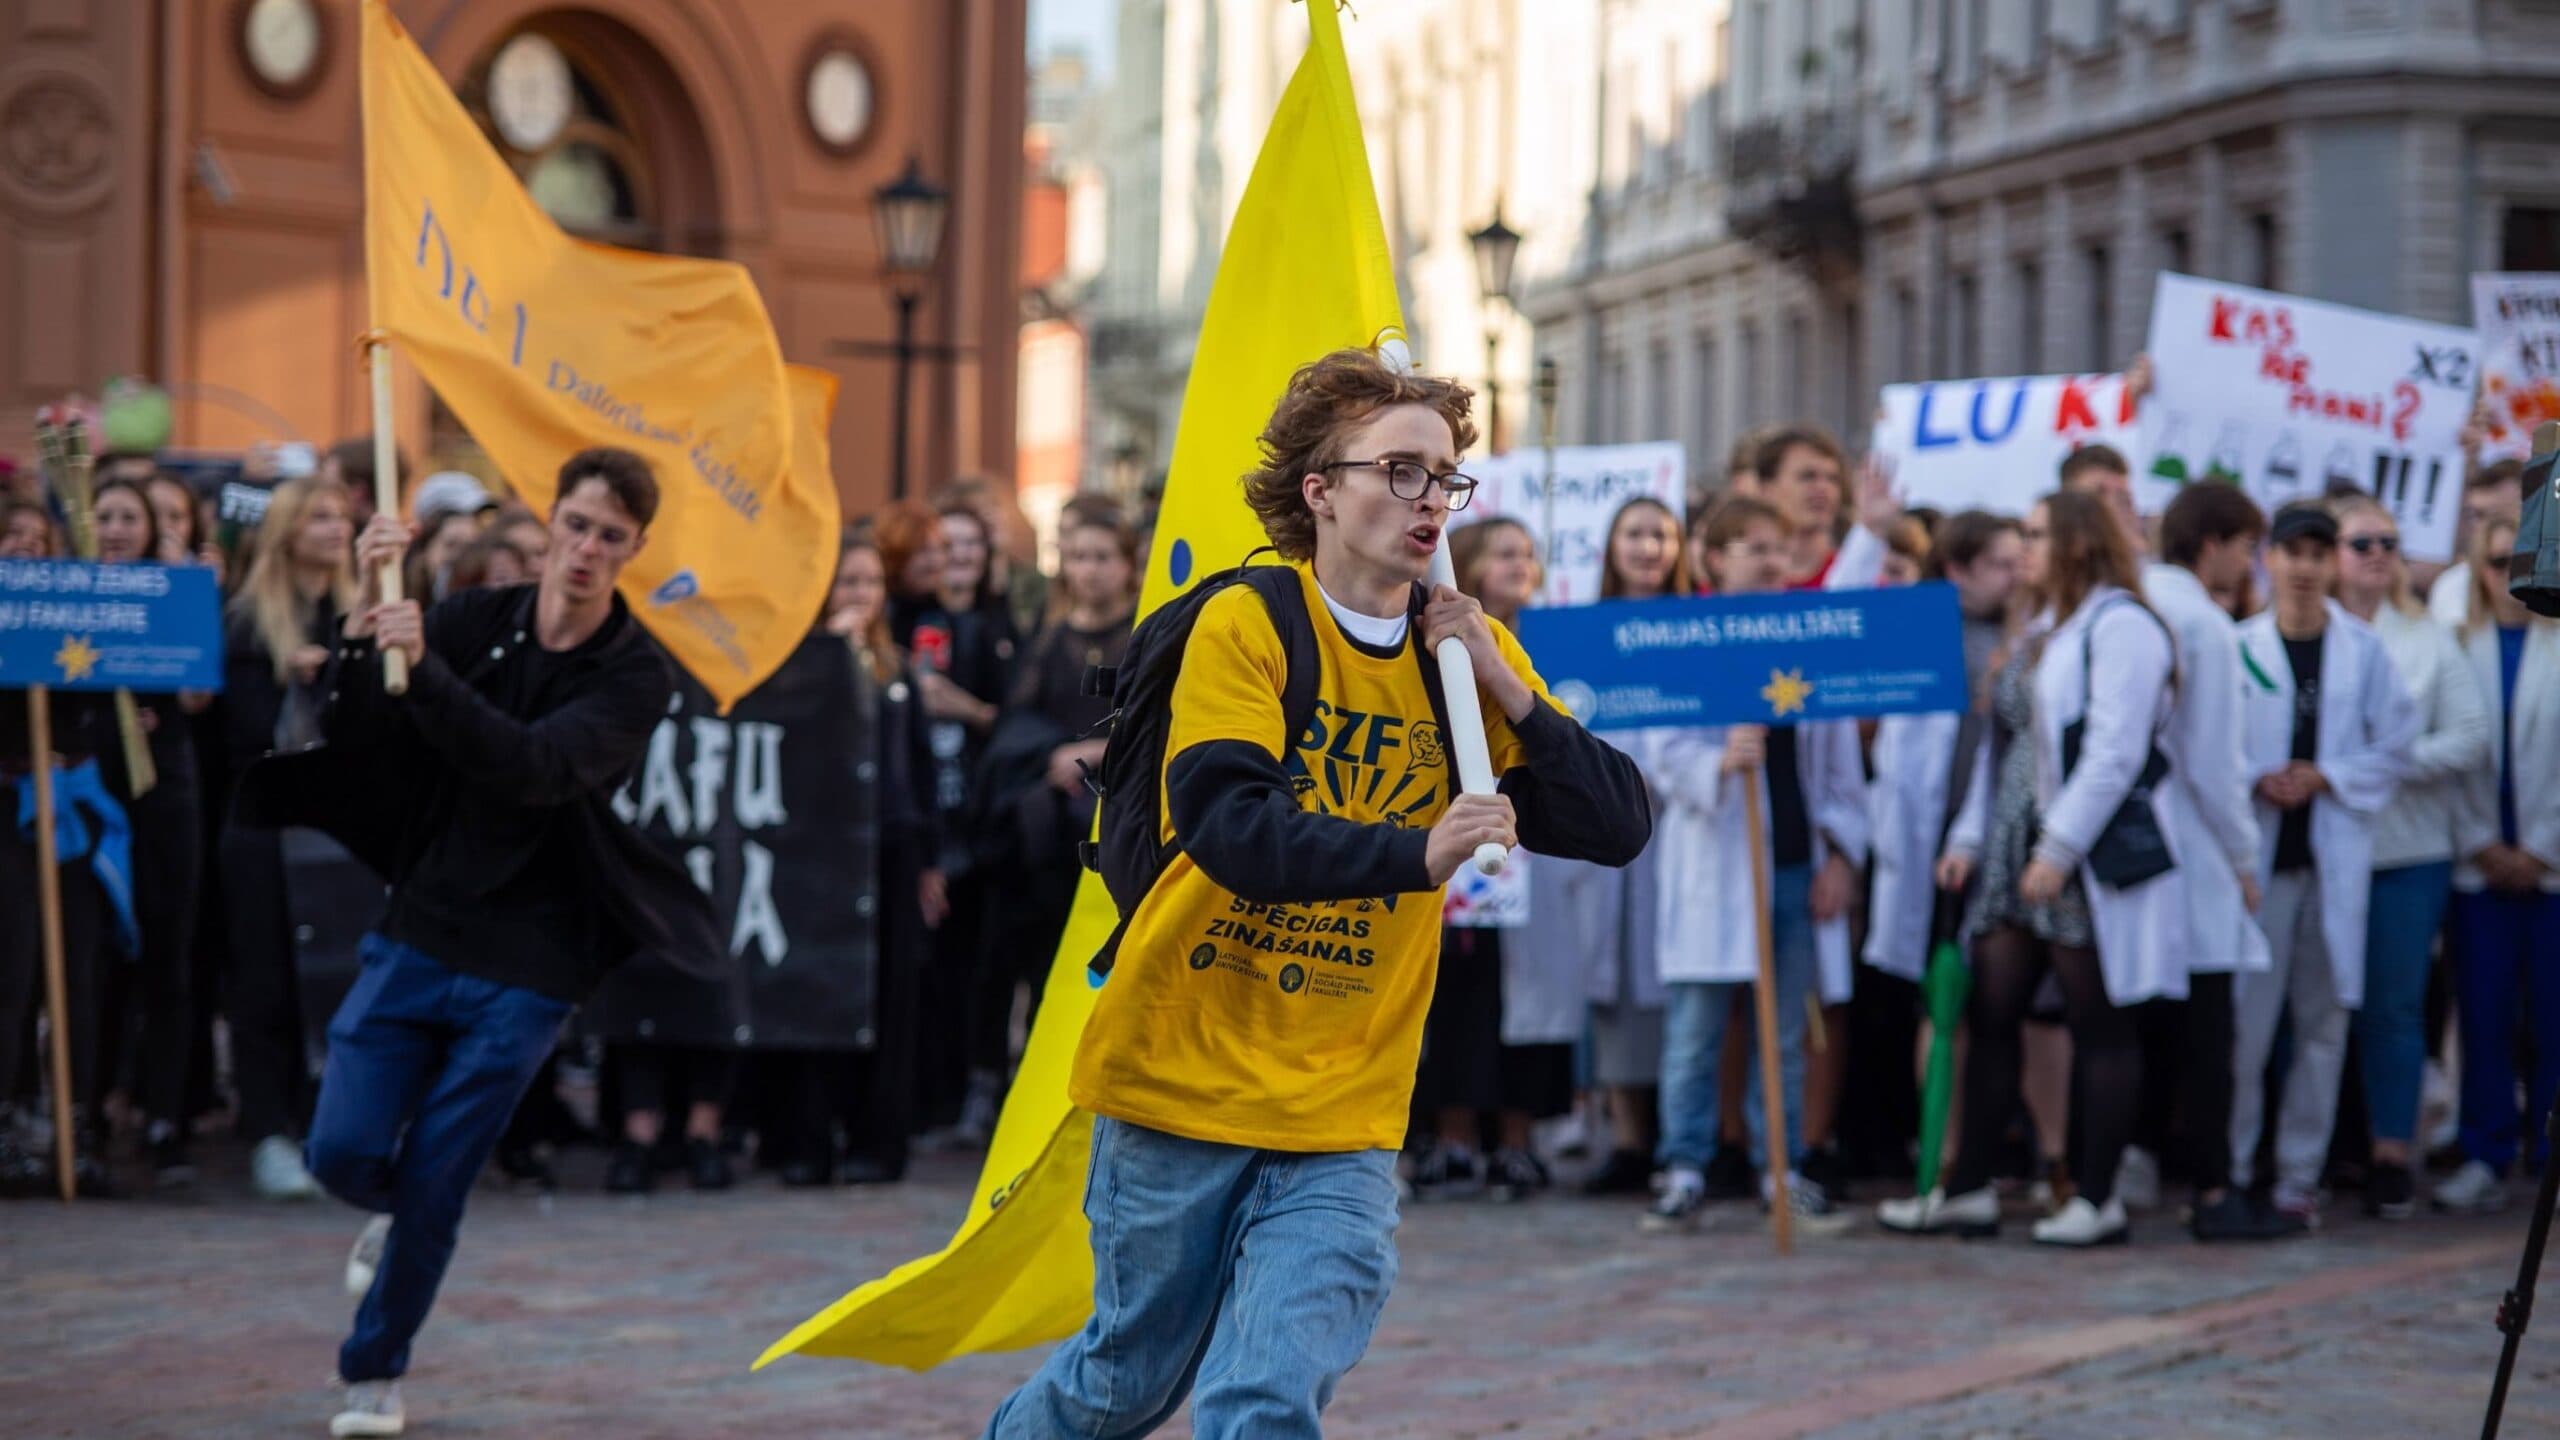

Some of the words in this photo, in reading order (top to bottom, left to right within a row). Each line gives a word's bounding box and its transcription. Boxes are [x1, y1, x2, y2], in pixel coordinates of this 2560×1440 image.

[1913, 376, 2032, 448] LU
[1297, 700, 1405, 767] SZF
[1205, 918, 1376, 967] ZINĀŠANAS
[1230, 897, 1371, 939] SPĒCĪGAS
